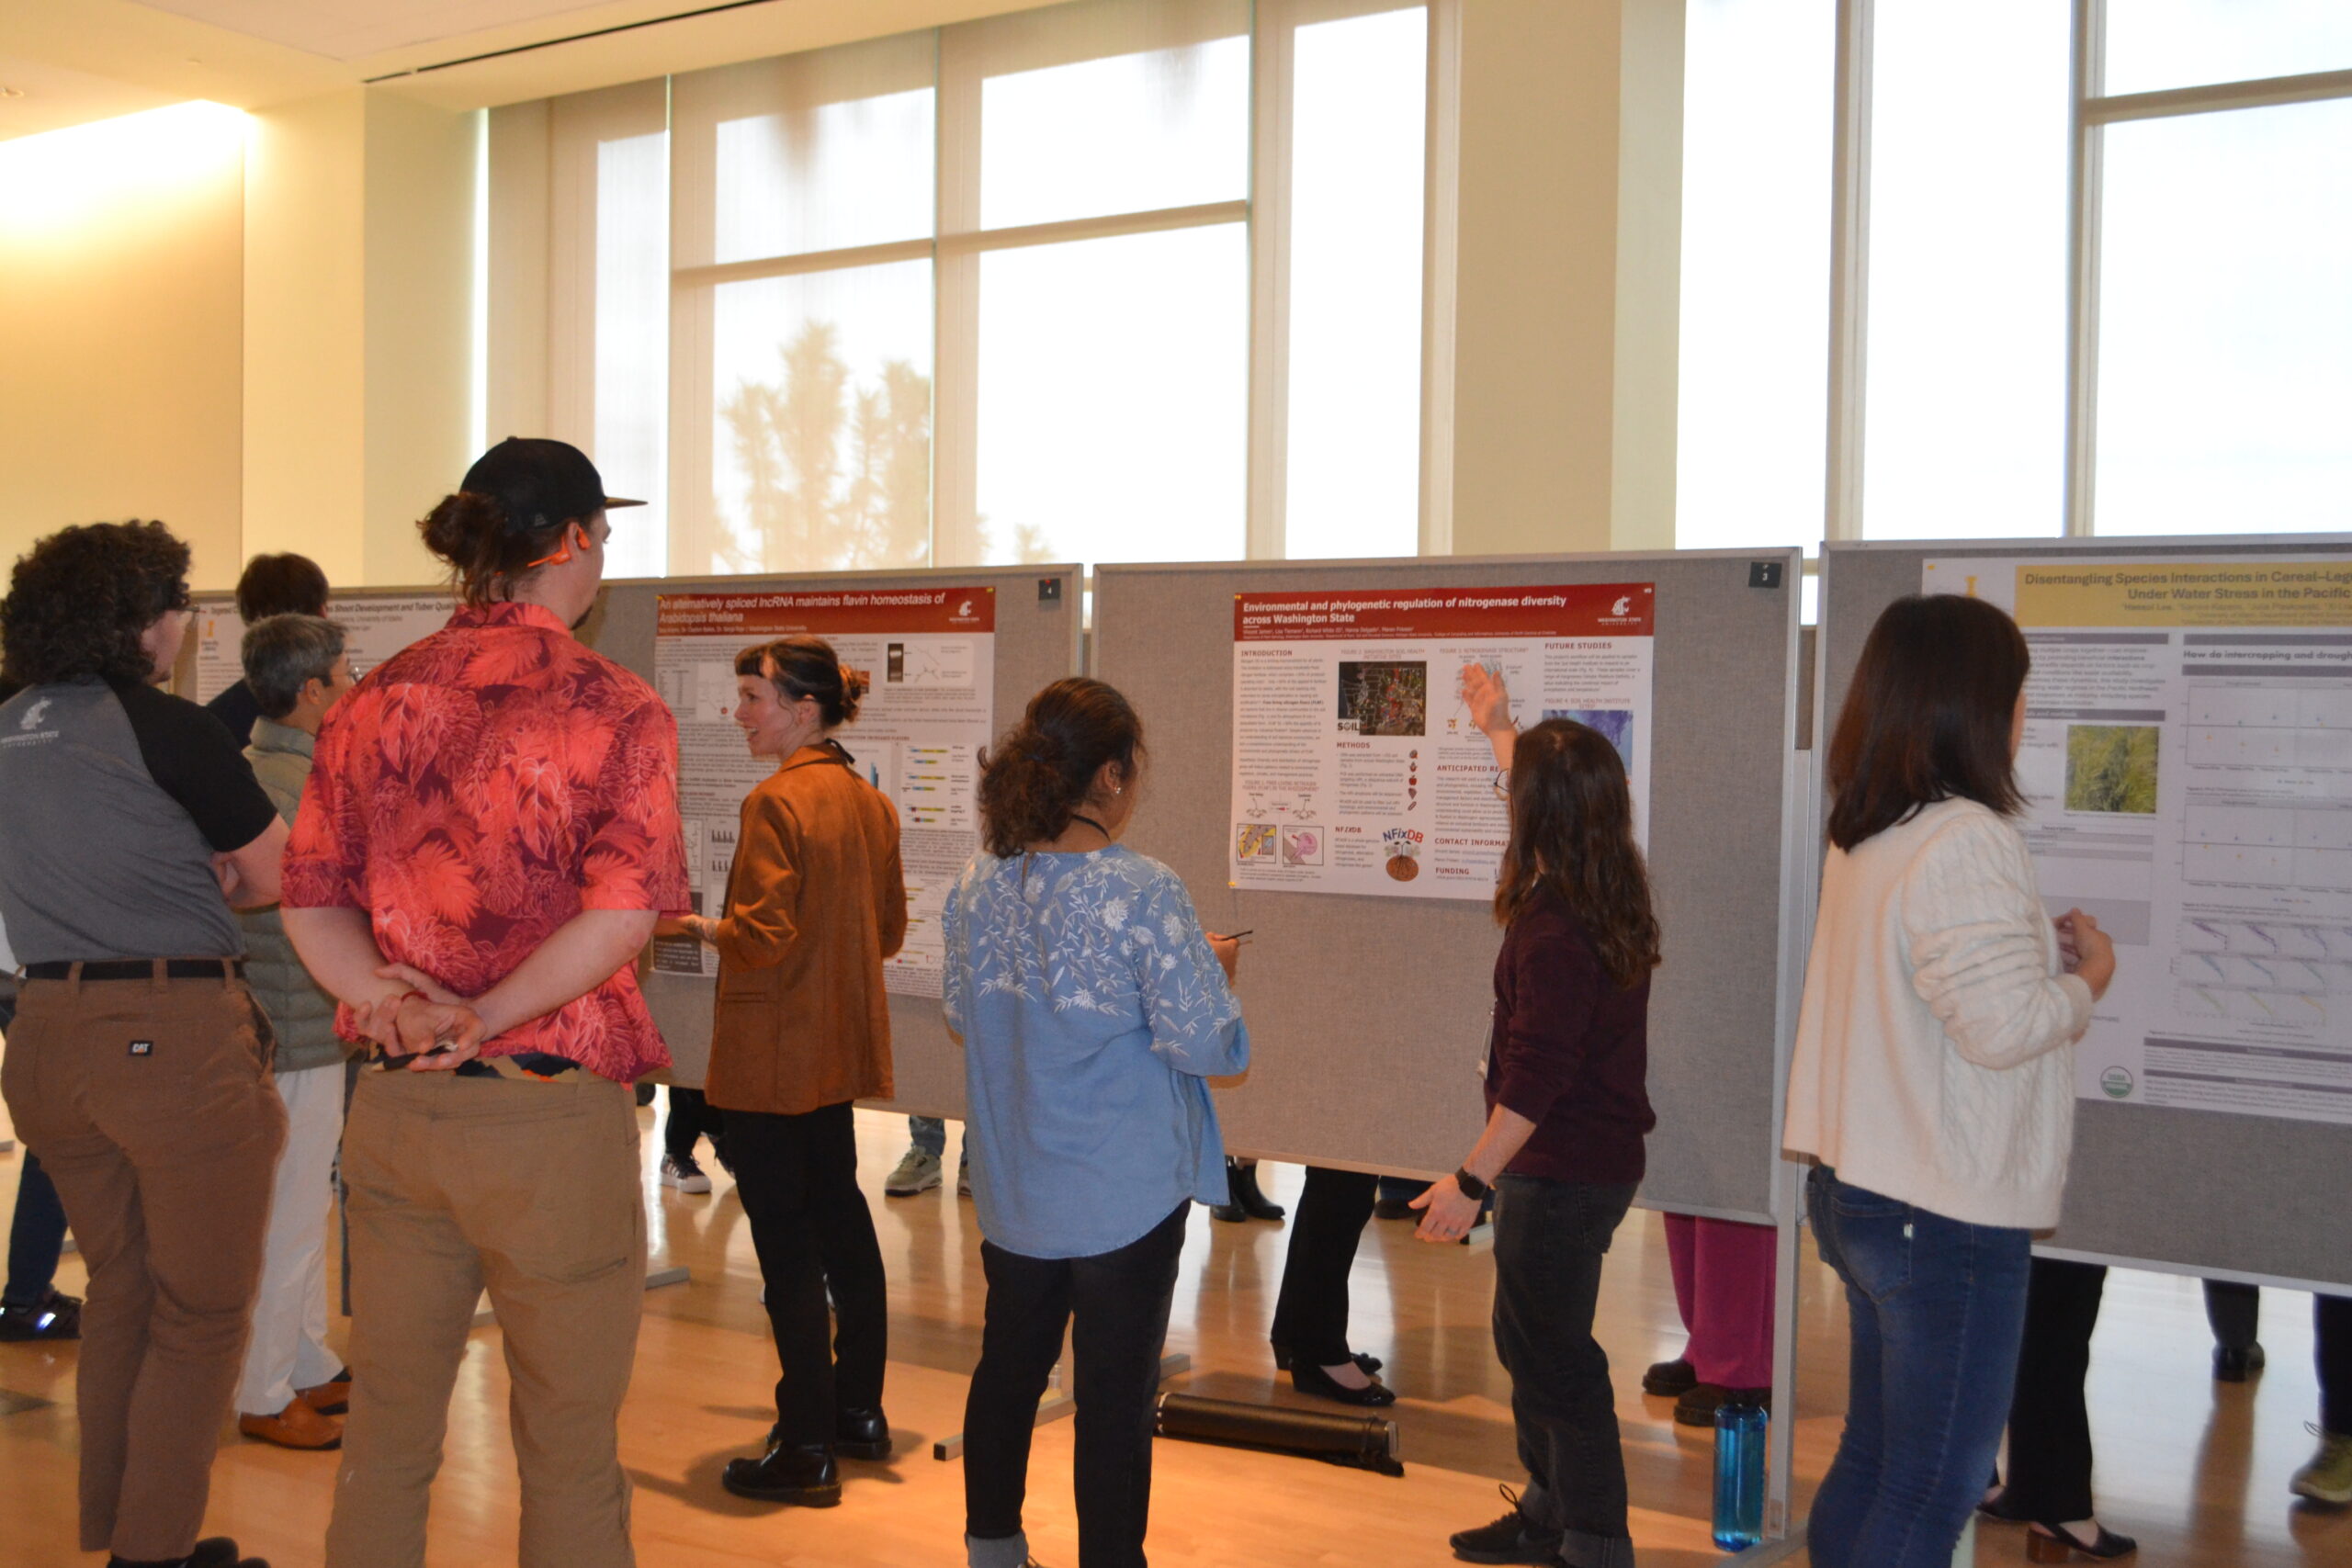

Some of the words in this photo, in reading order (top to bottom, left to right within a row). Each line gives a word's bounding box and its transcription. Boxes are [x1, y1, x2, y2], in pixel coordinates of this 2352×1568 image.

[2025, 573, 2113, 587] Disentangling
[2115, 572, 2167, 586] Species
[2170, 571, 2252, 583] Interactions
[2255, 571, 2267, 581] in
[2128, 589, 2168, 599] Under
[2171, 588, 2211, 599] Water
[2214, 588, 2258, 599] Stress
[2262, 588, 2274, 597] in
[2278, 588, 2300, 598] the
[2303, 587, 2352, 598] Pacific
[660, 599, 671, 609] An
[673, 598, 723, 611] alternatively
[725, 598, 758, 610] spliced
[796, 595, 841, 607] maintains
[842, 595, 868, 606] flavin
[870, 594, 932, 605] homeostasis
[934, 592, 945, 604] of
[1243, 602, 1308, 613] Environmental
[1310, 601, 1329, 611] and
[1330, 600, 1391, 613] phylogenetic
[1393, 598, 1442, 611] regulation
[1445, 597, 1456, 607] of
[1458, 596, 1519, 609] nitrogenase
[1521, 595, 1566, 608] diversity
[334, 604, 354, 612] Shoot
[355, 604, 400, 614] Development
[401, 603, 413, 612] and
[660, 613, 707, 625] Arabidopsis
[708, 612, 743, 623] thaliana
[1243, 615, 1272, 625] across
[1273, 614, 1327, 626] Washington
[1330, 613, 1355, 623] State
[2184, 650, 2206, 659] How
[2209, 650, 2222, 659] do
[2224, 650, 2291, 660] intercropping
[2294, 650, 2313, 659] and
[1338, 722, 1360, 731] SOIL
[1383, 828, 1424, 843] NFixDB
[1434, 838, 1468, 846] CONTACT
[1435, 867, 1469, 875] FUNDING
[132, 1043, 151, 1054] CAT
